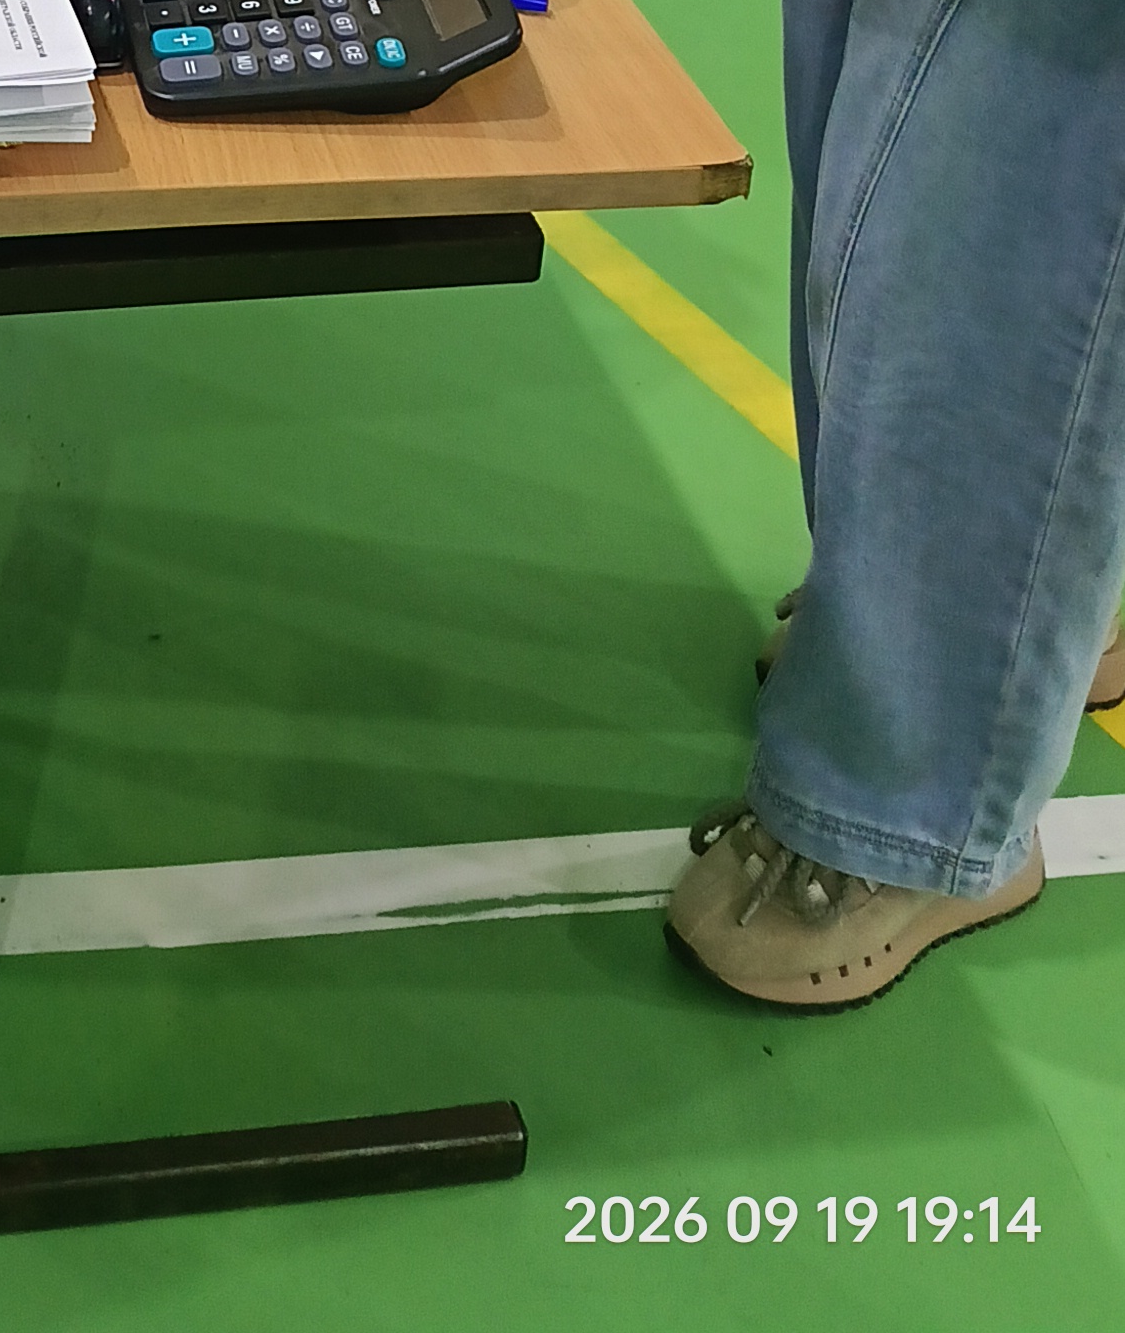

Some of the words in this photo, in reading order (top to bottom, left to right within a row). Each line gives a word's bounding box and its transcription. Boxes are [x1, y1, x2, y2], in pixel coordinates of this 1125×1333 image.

[198, 4, 217, 14] 3
[241, 0, 260, 10] 6
[336, 17, 354, 31] GT
[345, 46, 363, 61] CE
[236, 55, 253, 70] MU
